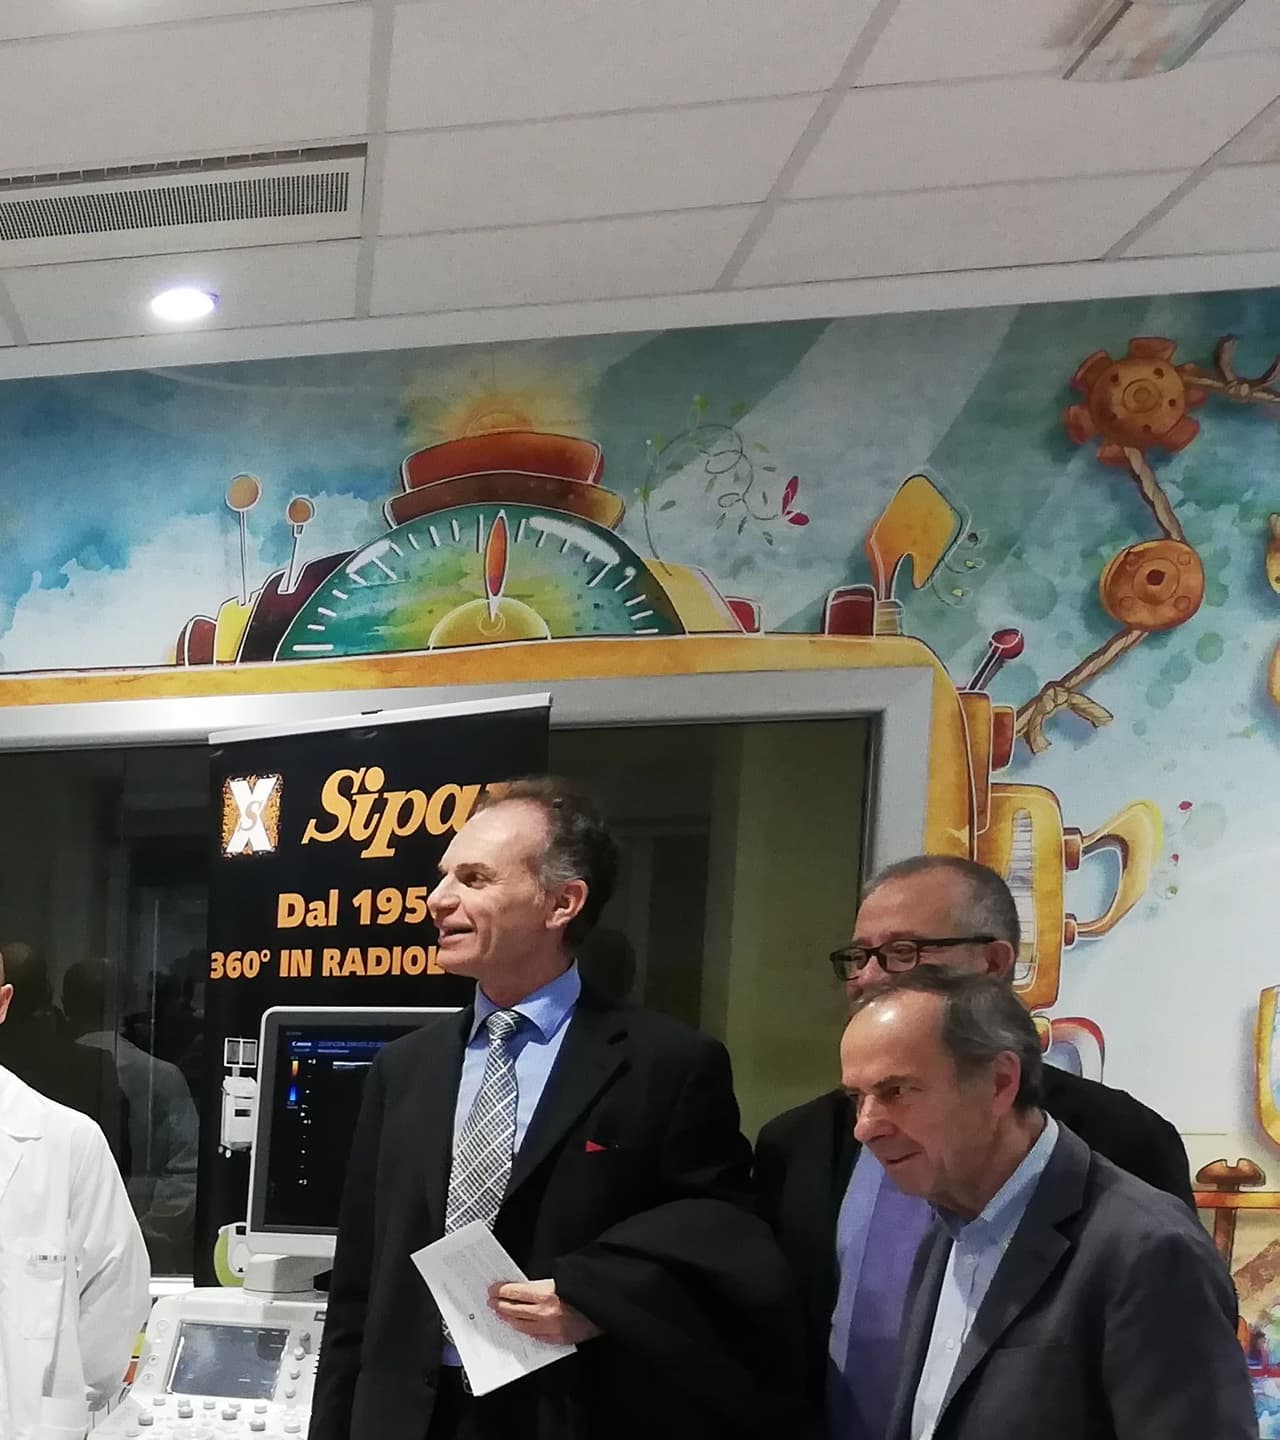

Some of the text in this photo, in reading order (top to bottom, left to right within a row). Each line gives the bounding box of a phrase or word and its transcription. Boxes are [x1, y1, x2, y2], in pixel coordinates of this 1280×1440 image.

[276, 886, 439, 929] Dal 195
[210, 946, 446, 979] 360° IN RADIOL
